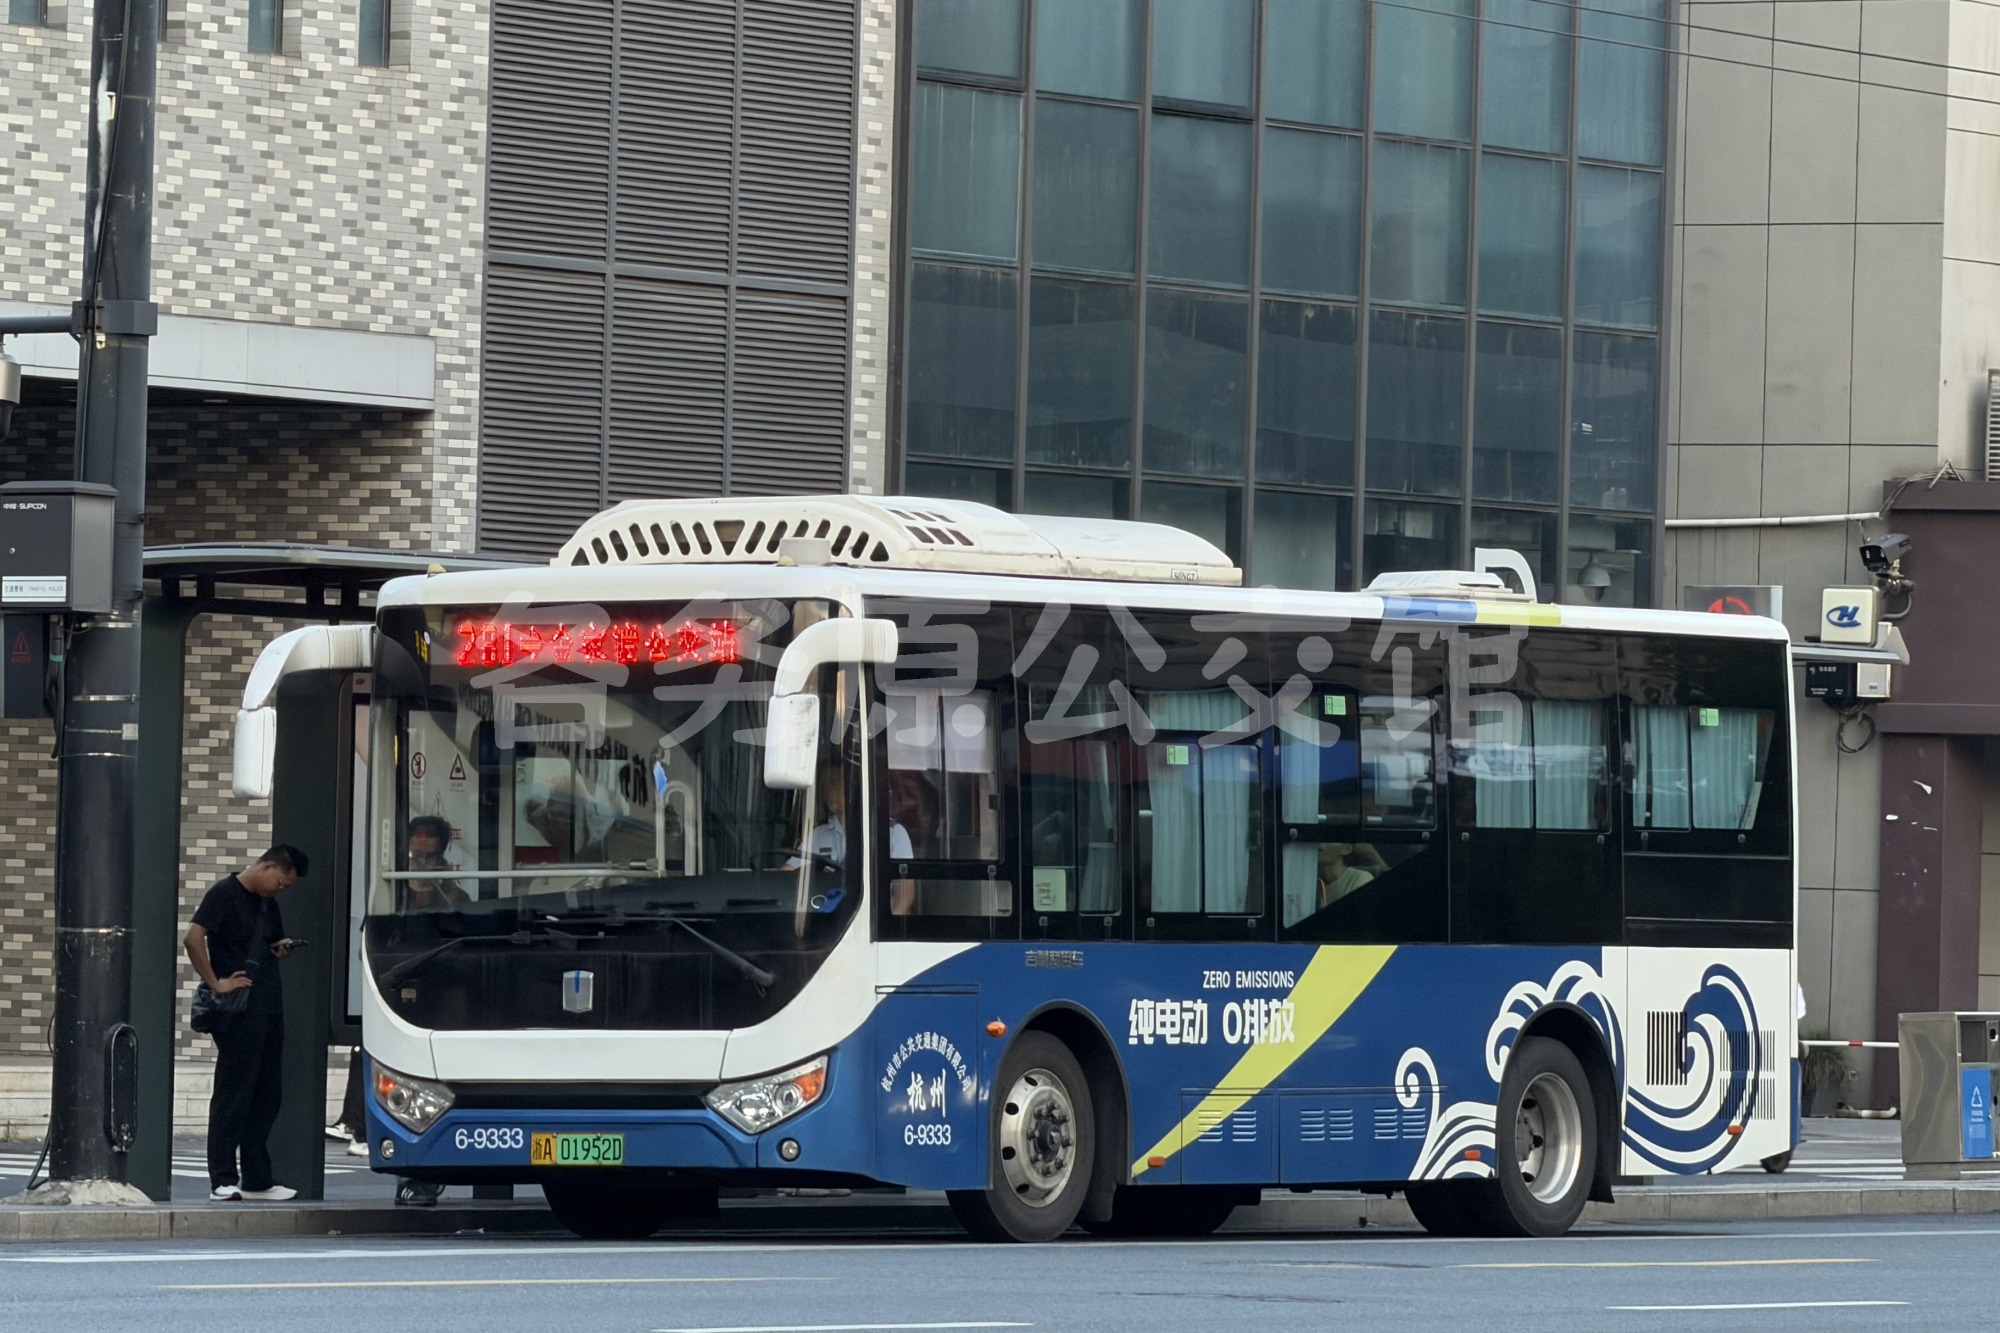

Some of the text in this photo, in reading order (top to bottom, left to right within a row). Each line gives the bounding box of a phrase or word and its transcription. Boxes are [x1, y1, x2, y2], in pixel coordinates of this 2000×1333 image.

[1202, 970, 1295, 988] ZERO EMISSIONS
[1128, 999, 1295, 1044] 纯电动 0排放
[880, 1031, 973, 1092] 杭州市公共交通集团有限公司
[906, 1067, 947, 1118] 杭州
[455, 1127, 524, 1149] 6-9333
[904, 1124, 951, 1145] 6-9333
